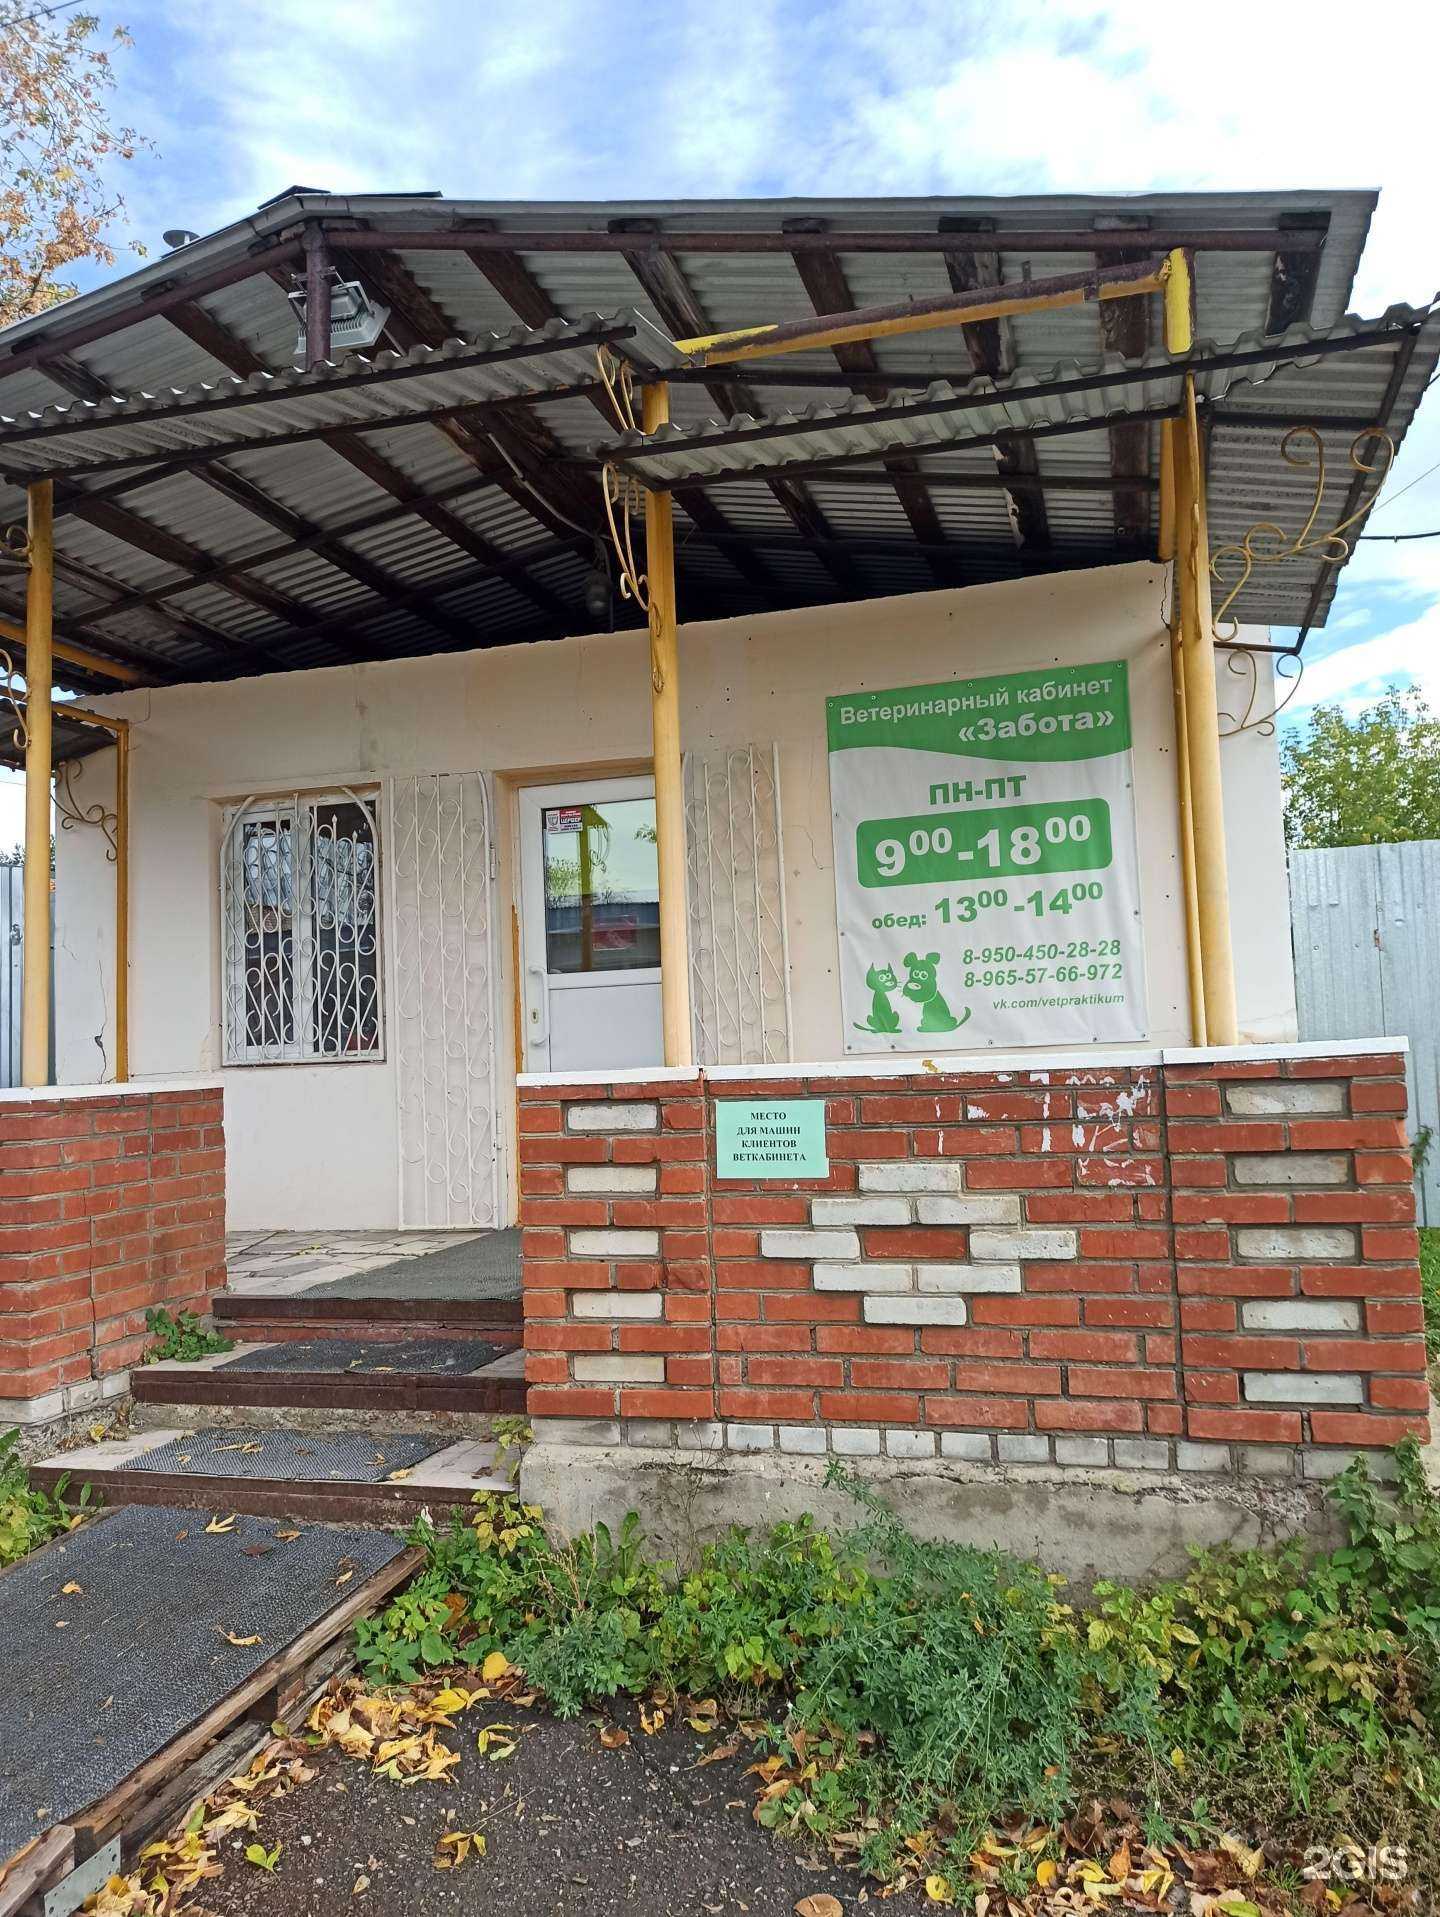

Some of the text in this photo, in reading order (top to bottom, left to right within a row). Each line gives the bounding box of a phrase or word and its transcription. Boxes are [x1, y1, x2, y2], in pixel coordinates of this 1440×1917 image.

[840, 678, 1113, 725] Ветеринарный кабинет
[958, 709, 1115, 742] «Забота»
[871, 913, 927, 929] обед:
[962, 939, 1121, 965] 8-950-450-28-28
[964, 963, 1123, 988] 8-965-57-66-972
[993, 993, 1125, 1010] vk.com/vetpraktikum
[750, 1111, 787, 1121] МЕСТО
[736, 1126, 801, 1136] ДЛЯ МАШИН
[741, 1139, 797, 1148] КЛИЕНТОВ
[733, 1152, 807, 1162] ВЕТКАБИНЕТА
